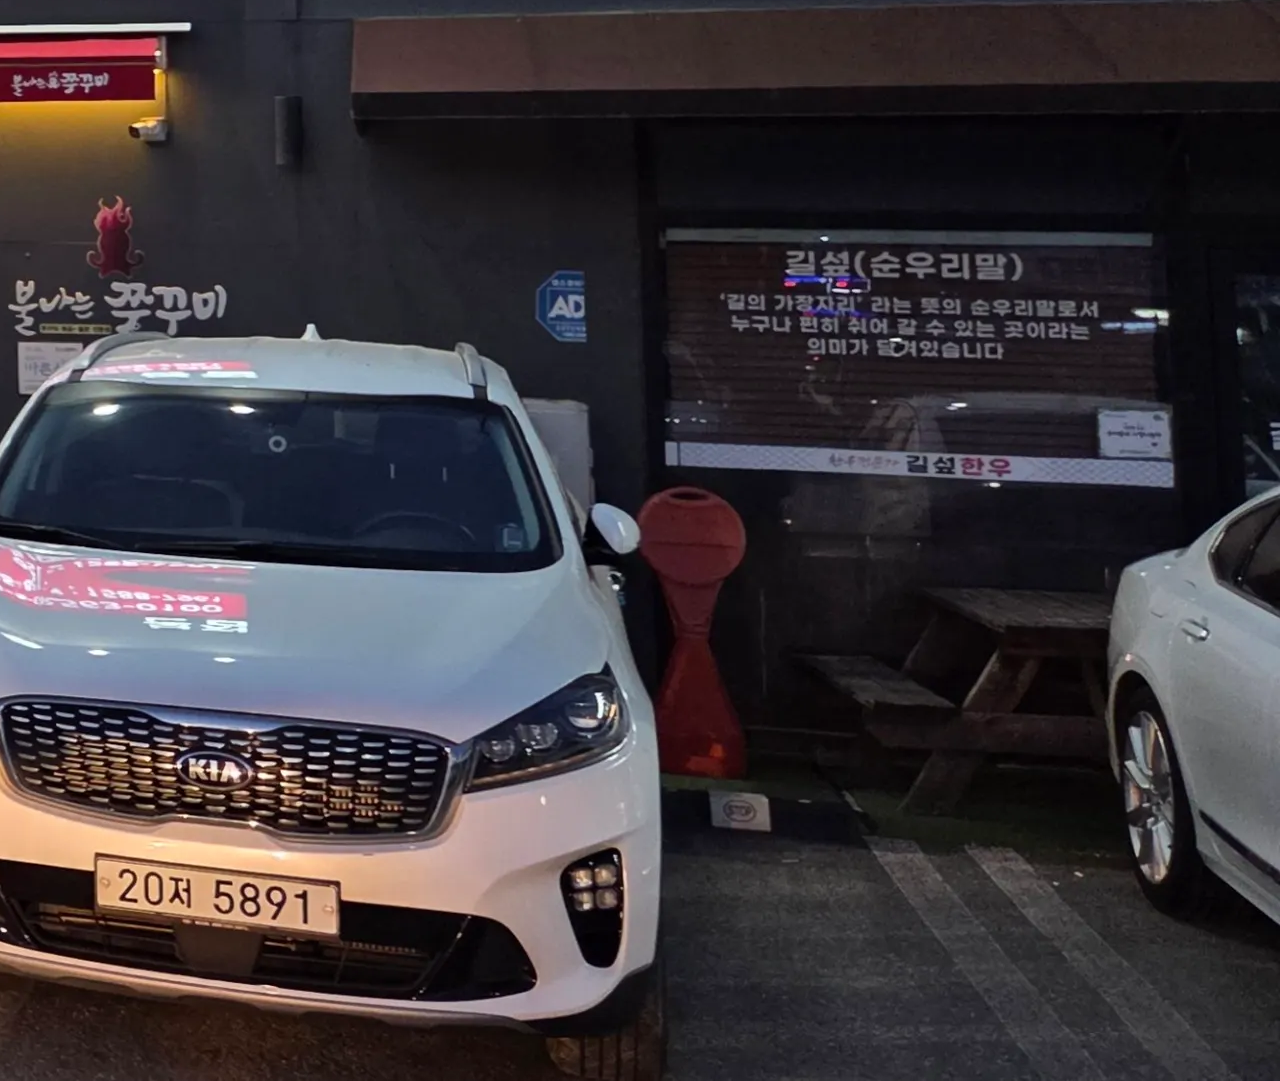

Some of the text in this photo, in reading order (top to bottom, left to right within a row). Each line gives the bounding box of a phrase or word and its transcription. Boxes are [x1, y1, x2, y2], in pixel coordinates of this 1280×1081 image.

[785, 250, 1024, 281] 길섶(순우리말)
[8, 280, 95, 336] 불나는
[871, 297, 911, 314] 라는
[920, 297, 962, 315] 뜻의
[970, 299, 1100, 318] 순우리말로서
[731, 315, 1090, 341] 누구나 편히 쉬어 갈 수 있는 곳이라는
[807, 338, 868, 356] 의미가
[186, 756, 242, 784] KIA
[116, 866, 312, 925] 20저 5891
